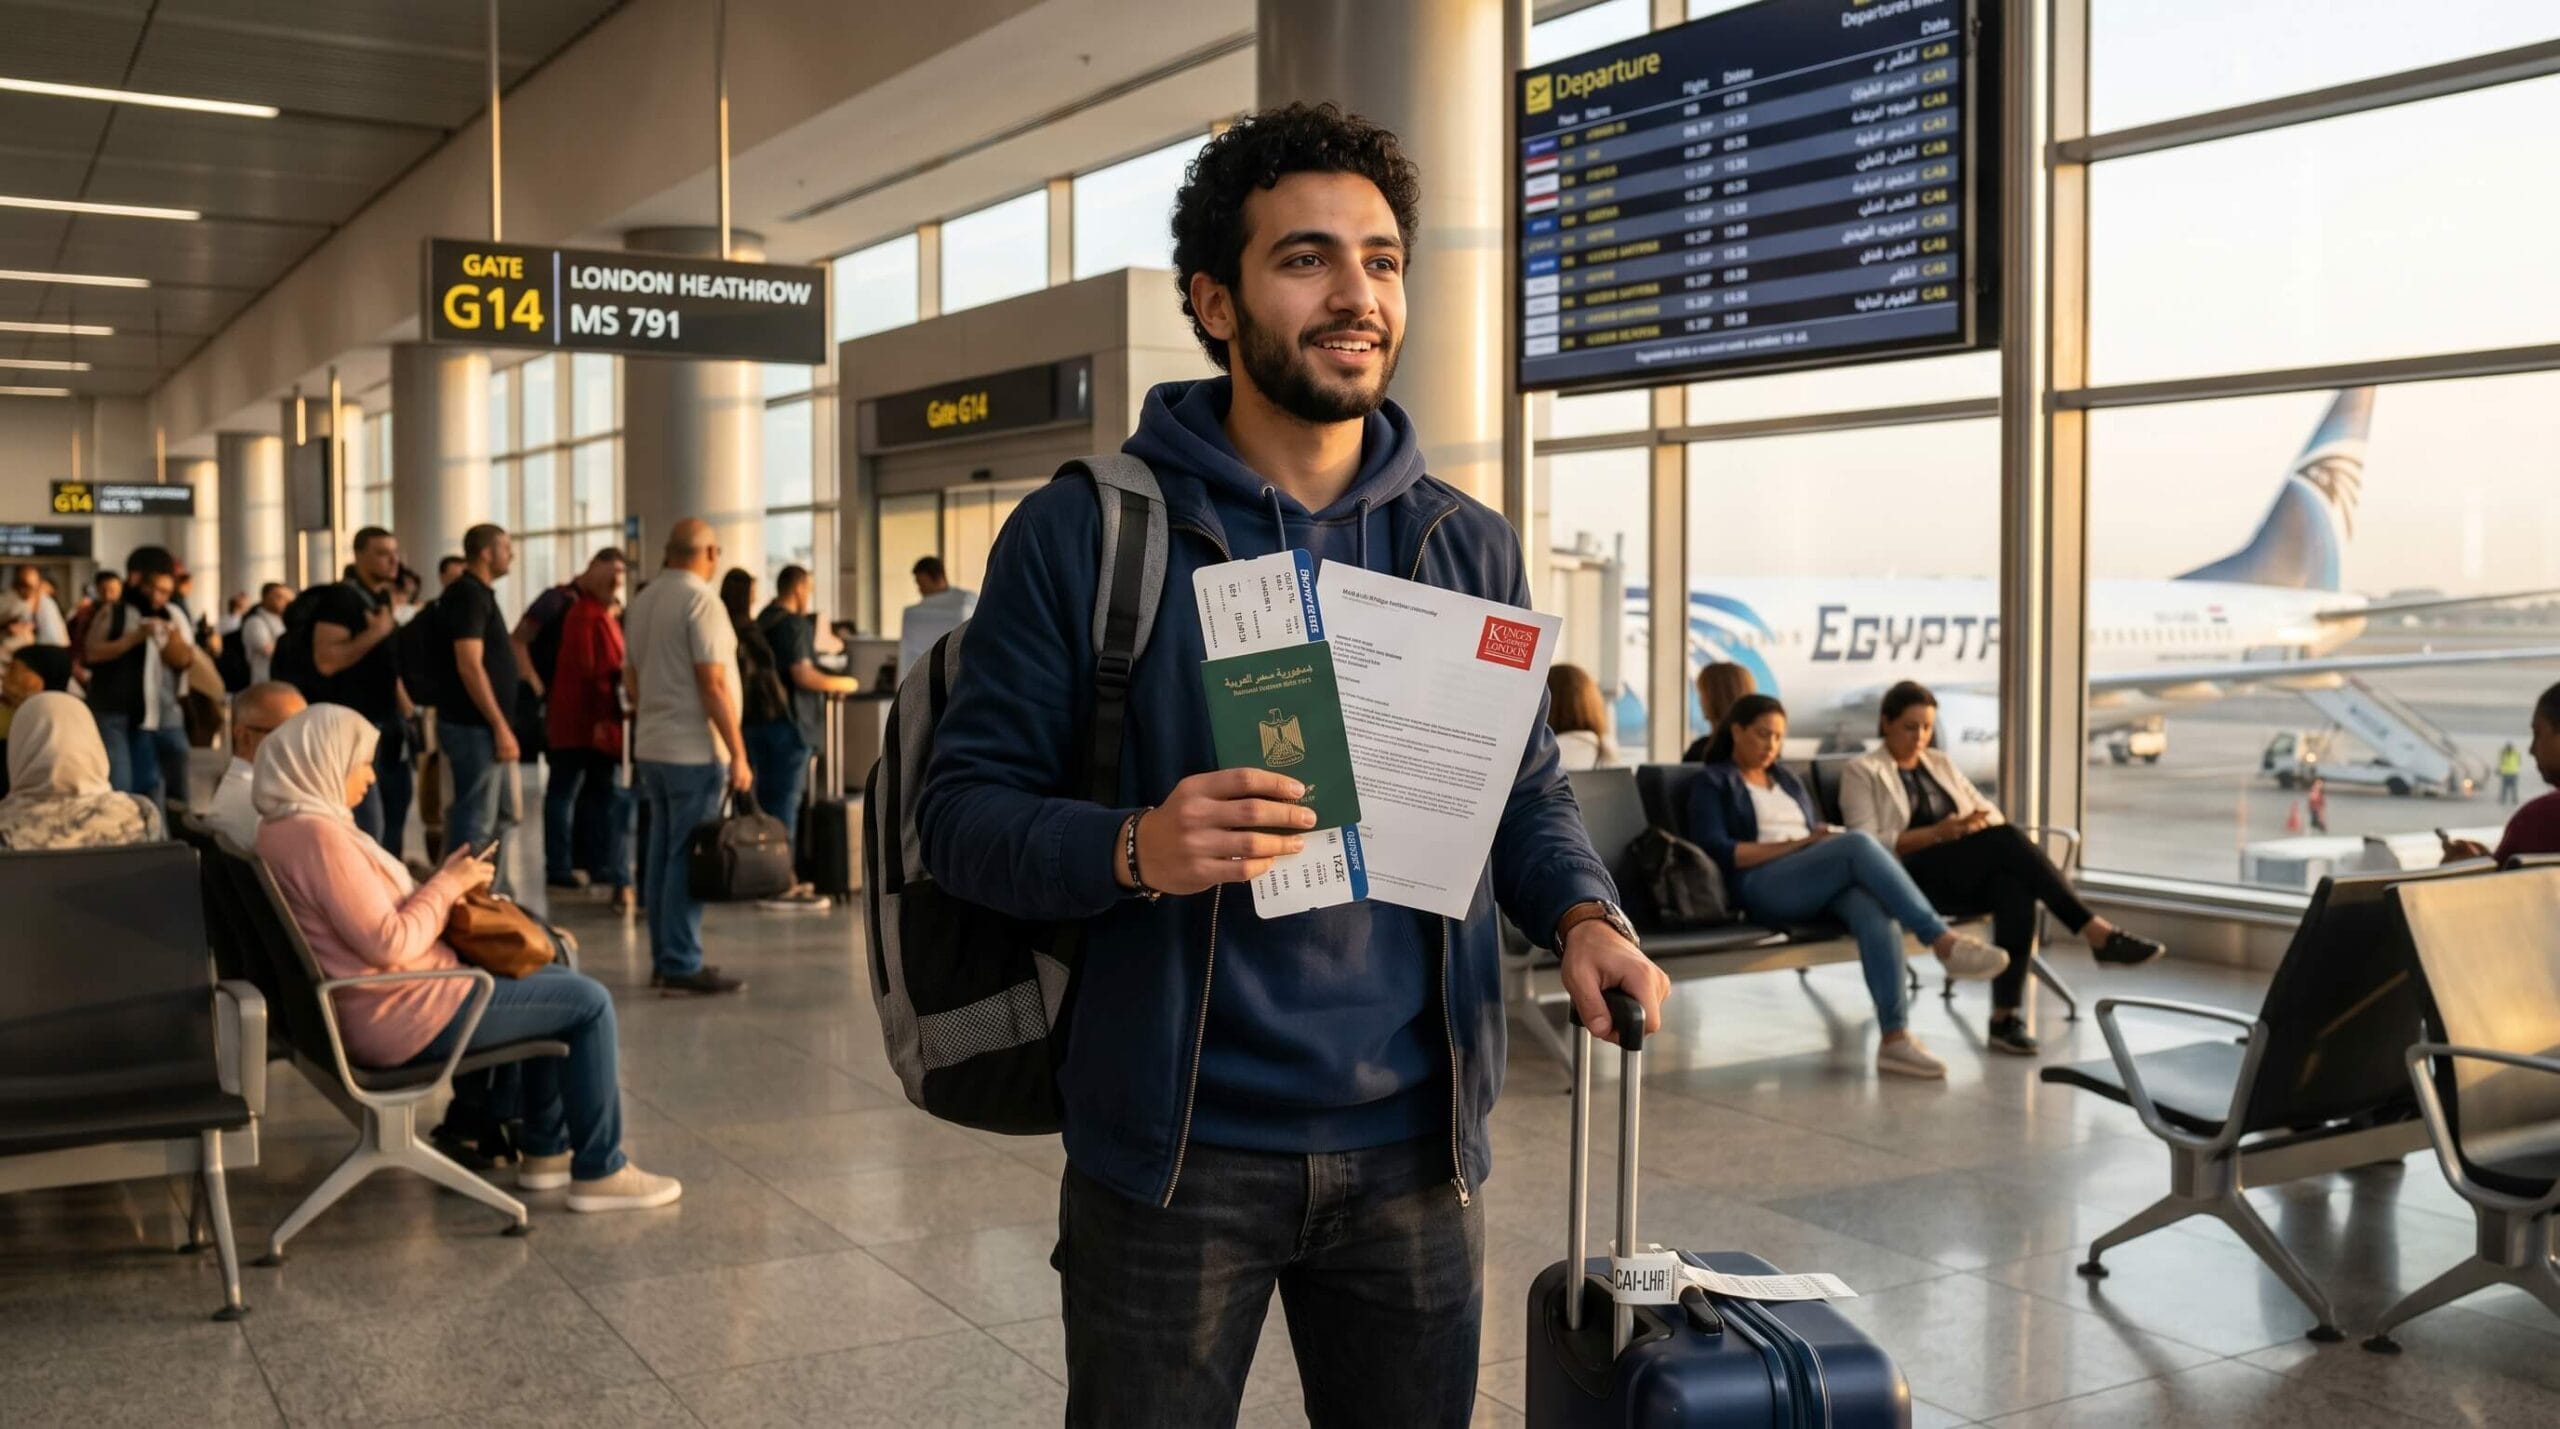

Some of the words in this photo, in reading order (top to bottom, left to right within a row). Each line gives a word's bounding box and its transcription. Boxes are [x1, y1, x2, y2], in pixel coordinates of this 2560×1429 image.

[1556, 52, 1661, 98] Departure
[462, 253, 524, 280] GATE
[570, 266, 673, 296] LONDON
[680, 272, 812, 306] HEATHROW
[443, 284, 544, 332] G14
[570, 304, 620, 336] MS
[627, 307, 681, 339] 791
[958, 391, 988, 424] G14
[1615, 1268, 1665, 1291] CAI-LHR
